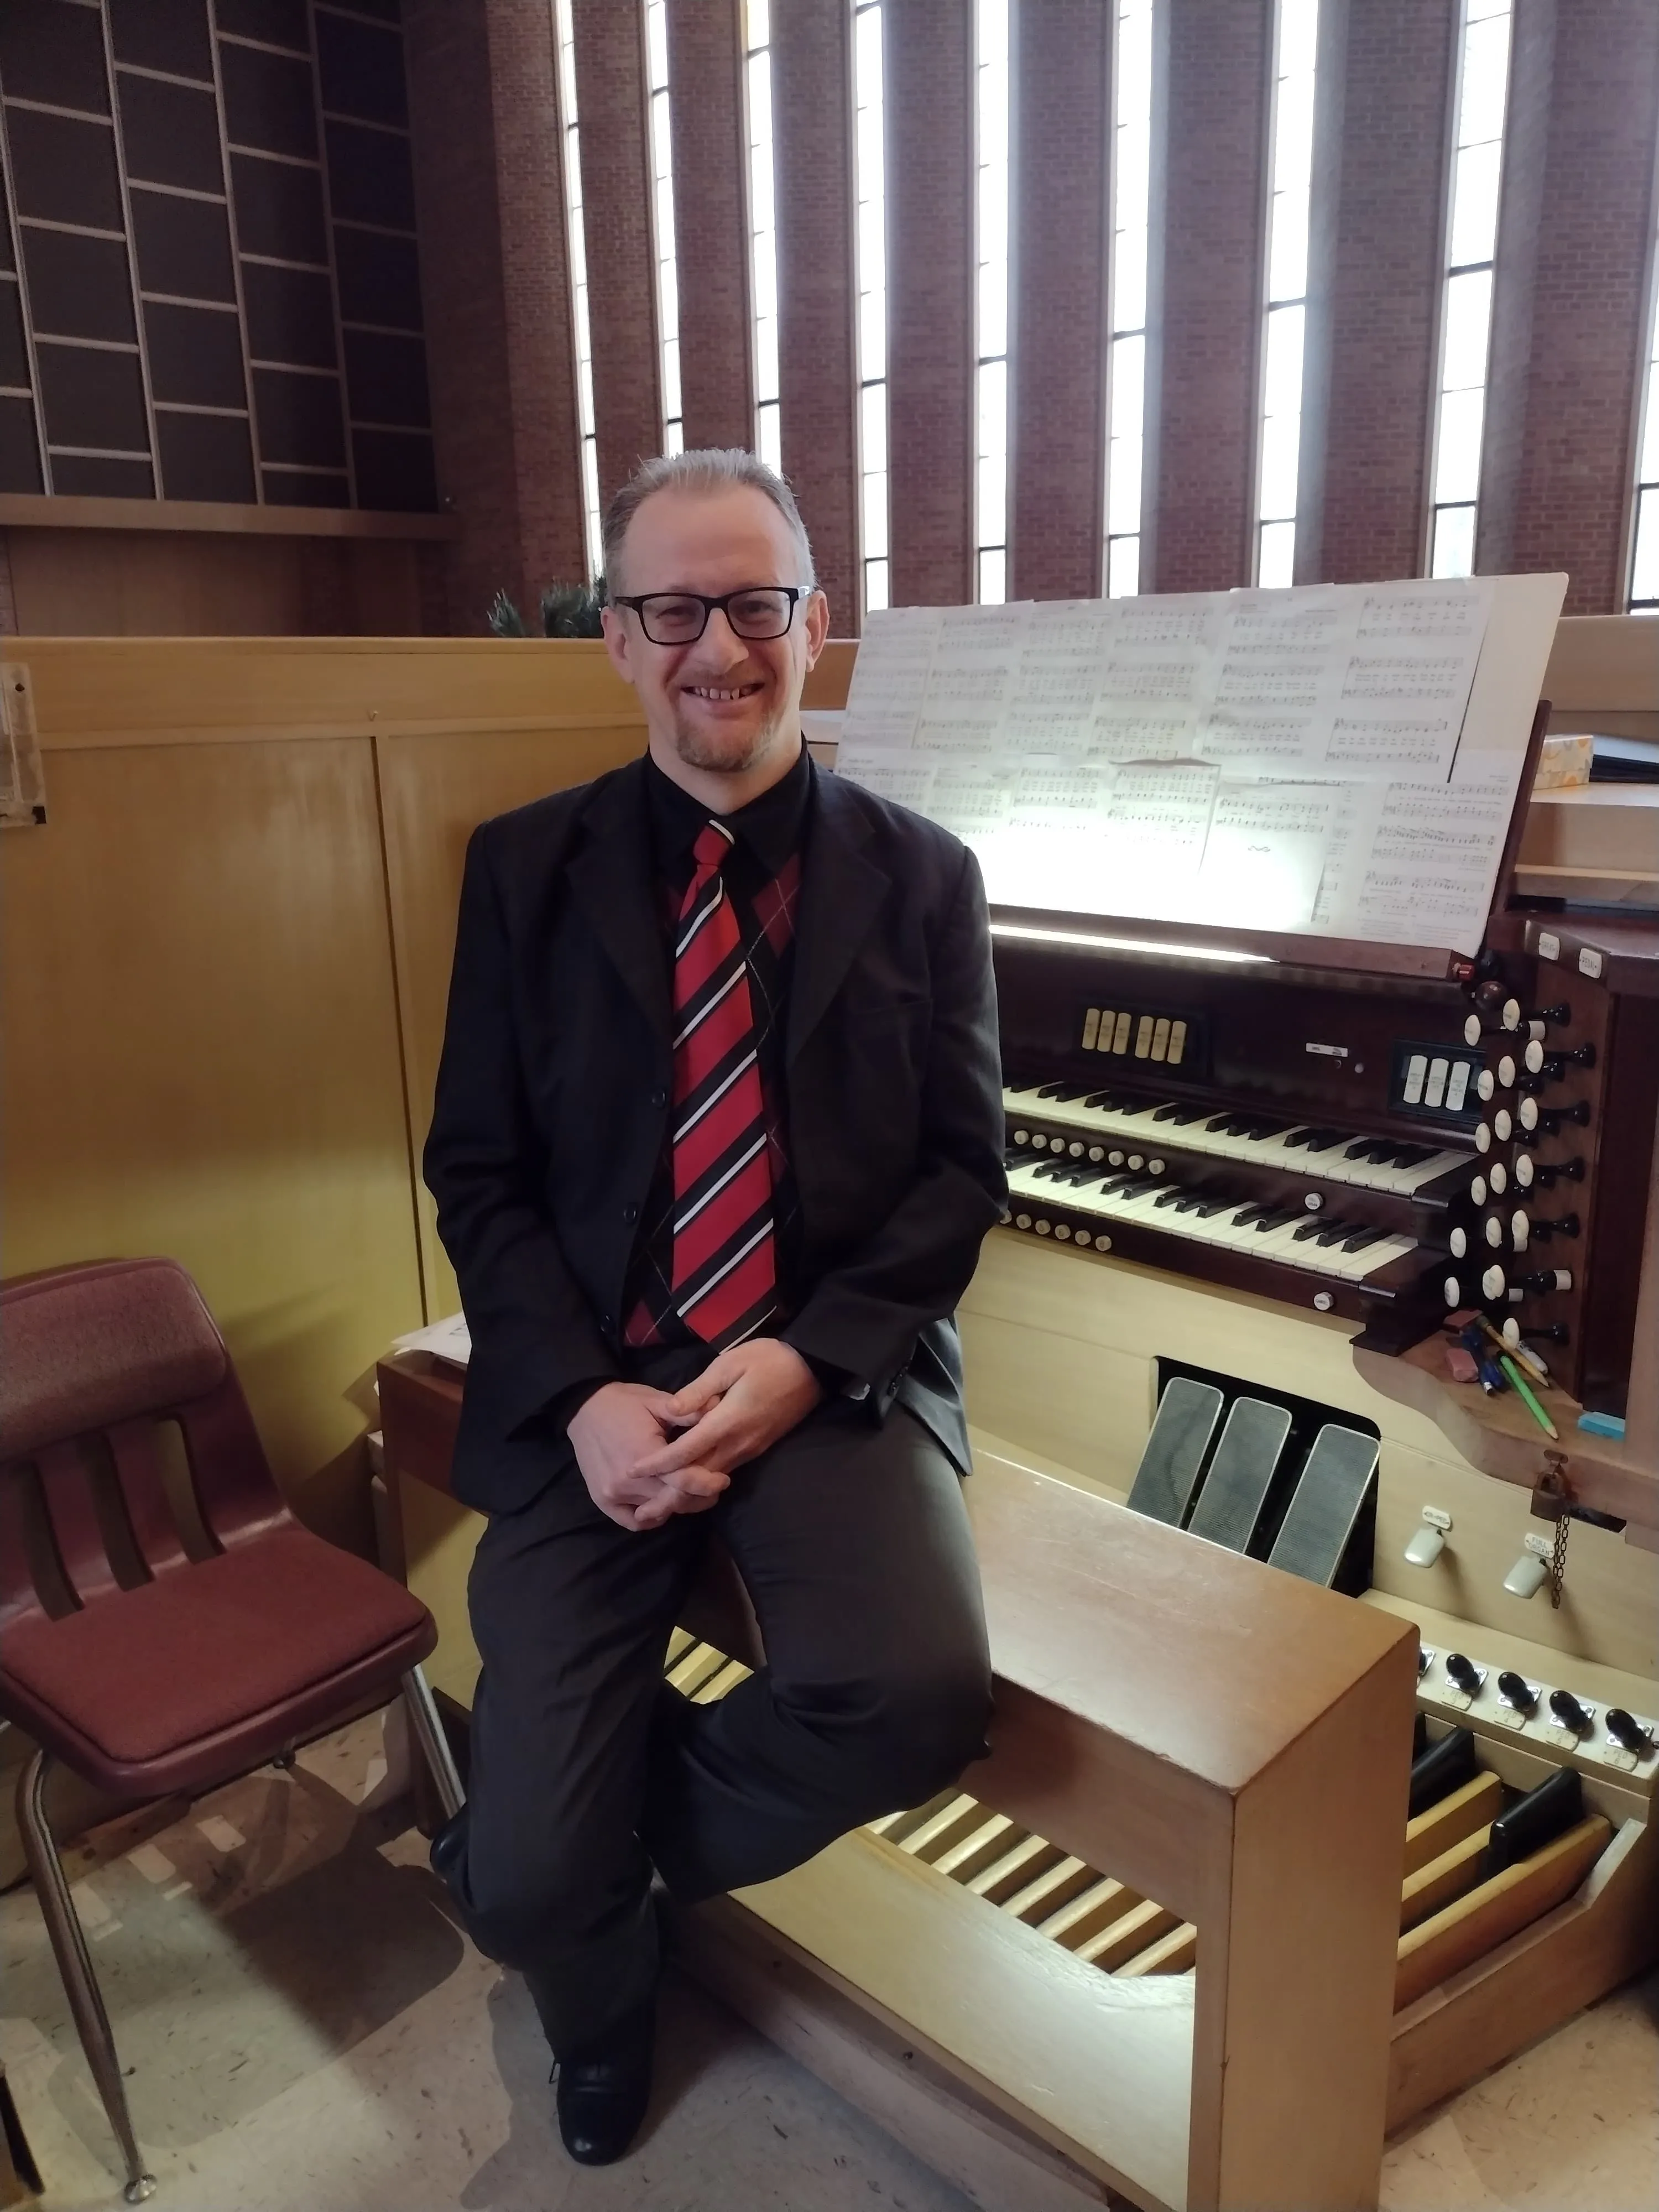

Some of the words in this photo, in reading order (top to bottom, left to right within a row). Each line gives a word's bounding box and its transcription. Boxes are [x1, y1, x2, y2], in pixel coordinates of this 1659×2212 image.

[1532, 1537, 1547, 1549] FULL
[1528, 1542, 1550, 1556] ORGAN
[1451, 1690, 1465, 1699] PED
[1504, 1710, 1517, 1718] PED
[1614, 1749, 1628, 1759] PED
